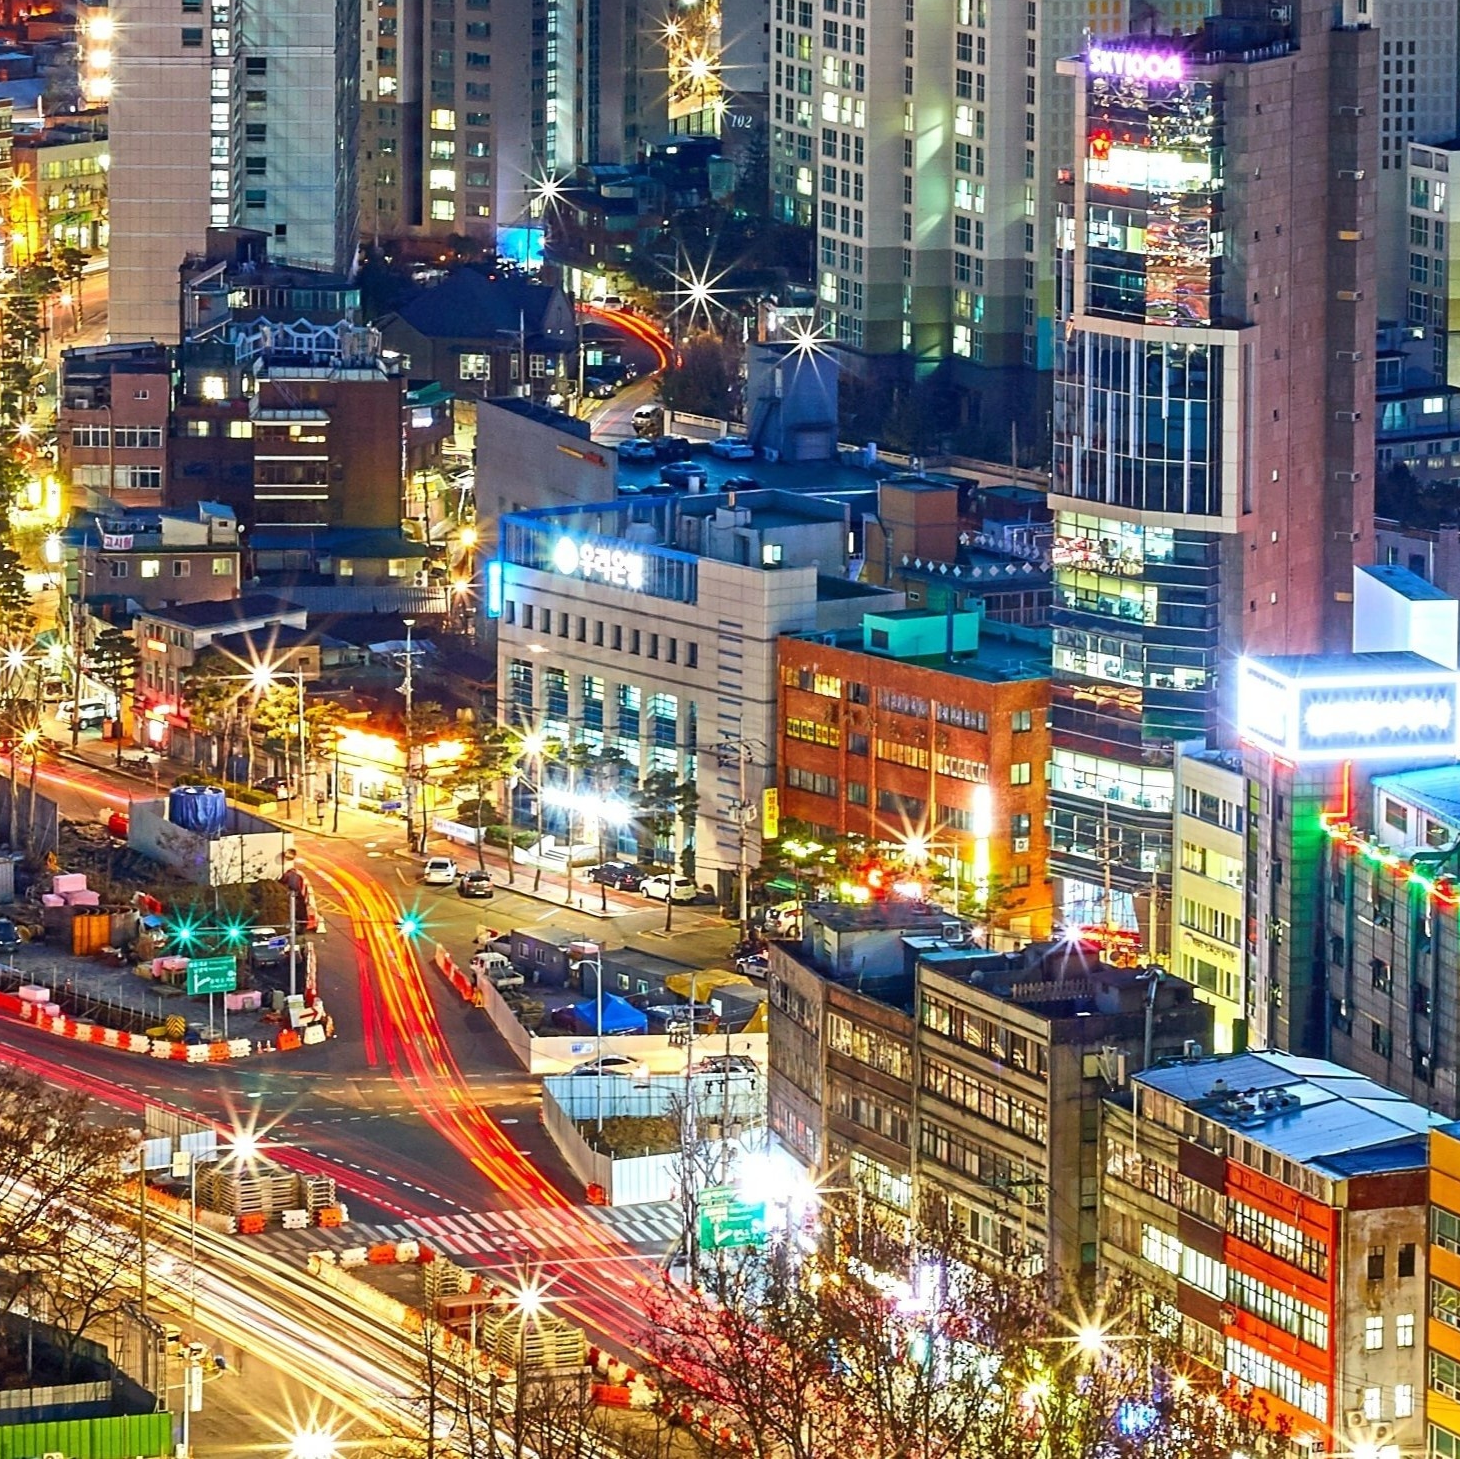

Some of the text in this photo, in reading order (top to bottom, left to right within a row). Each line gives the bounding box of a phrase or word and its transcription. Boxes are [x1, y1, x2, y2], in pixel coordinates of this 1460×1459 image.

[1089, 48, 1182, 80] SKY1004
[731, 116, 753, 129] 102
[579, 544, 643, 589] 우리은행
